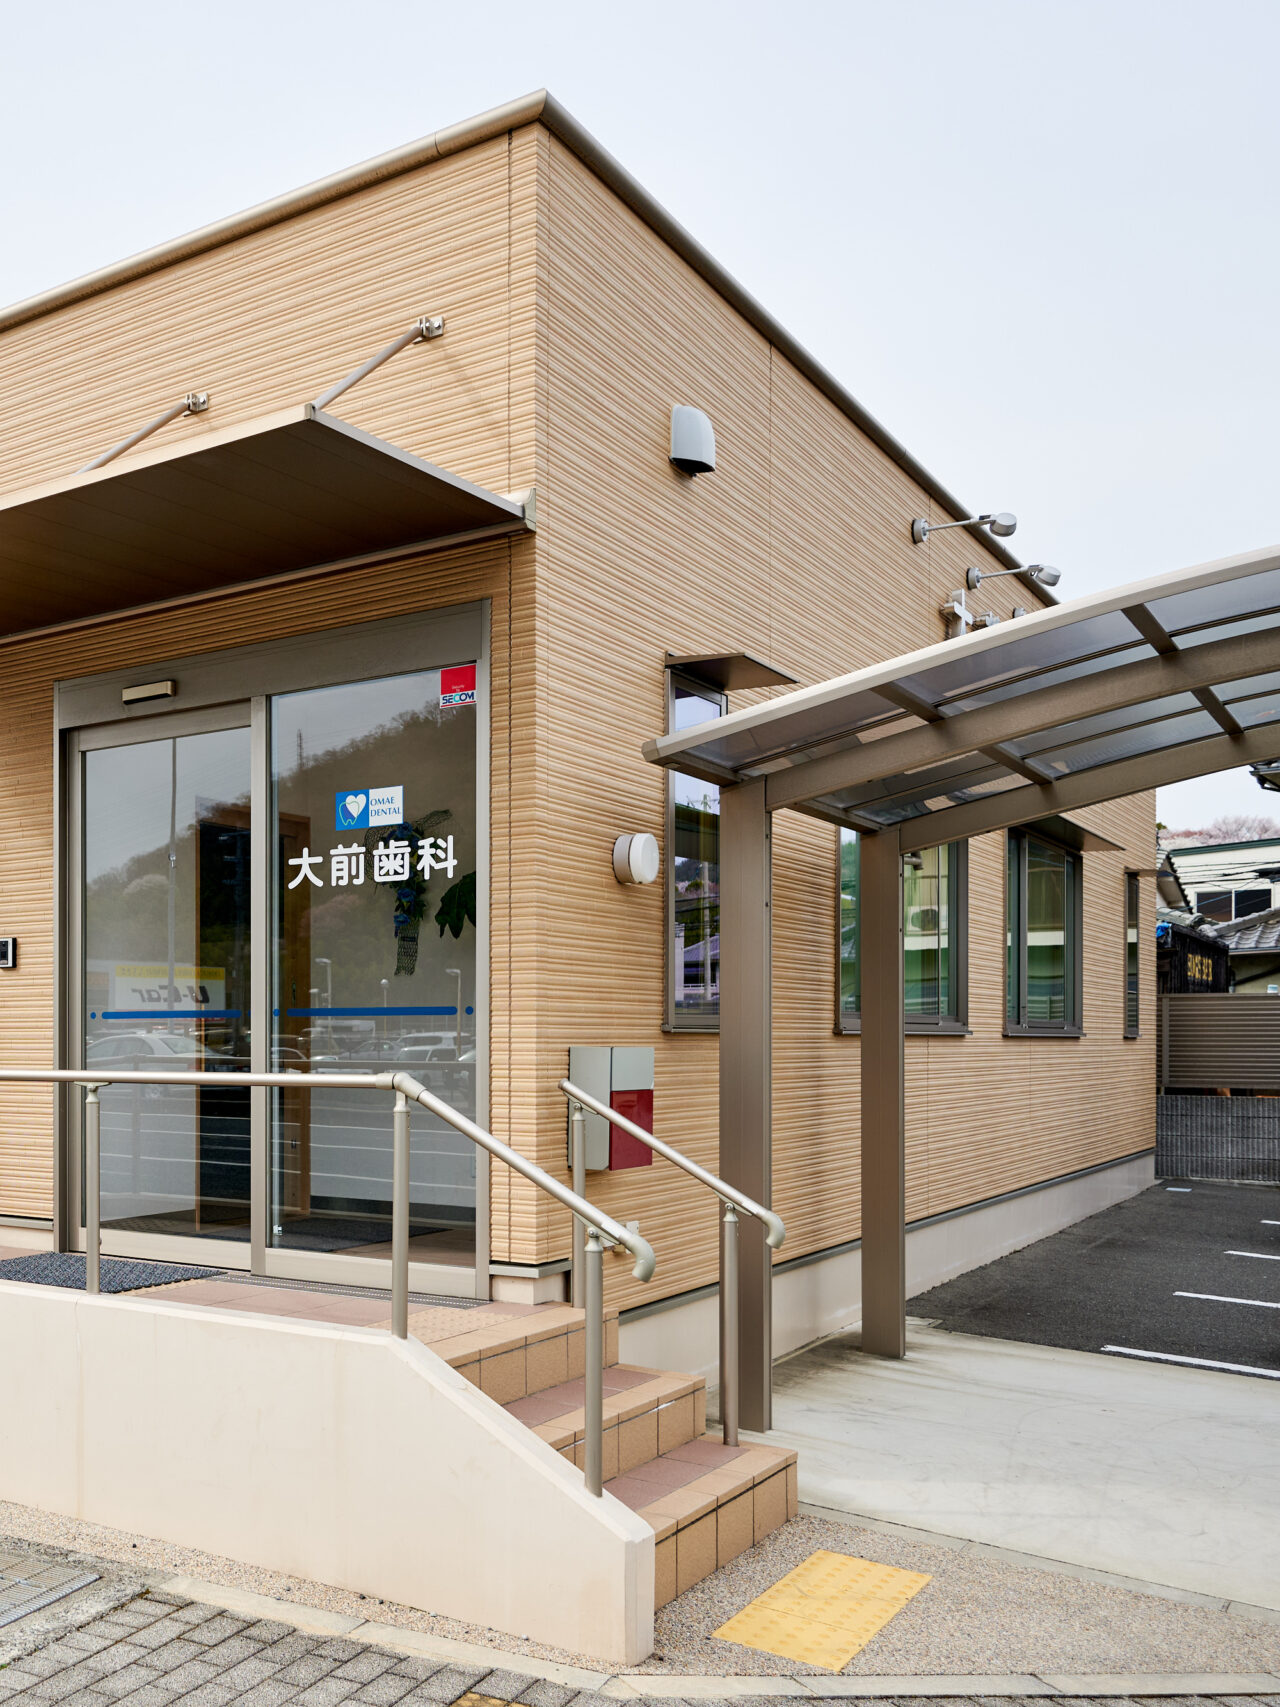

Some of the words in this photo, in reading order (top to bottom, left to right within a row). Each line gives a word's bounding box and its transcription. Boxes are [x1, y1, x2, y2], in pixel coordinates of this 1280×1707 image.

[442, 691, 475, 705] SECOM
[370, 795, 395, 806] OMAE
[370, 806, 401, 817] DENTAL
[287, 834, 458, 890] 大前歯科
